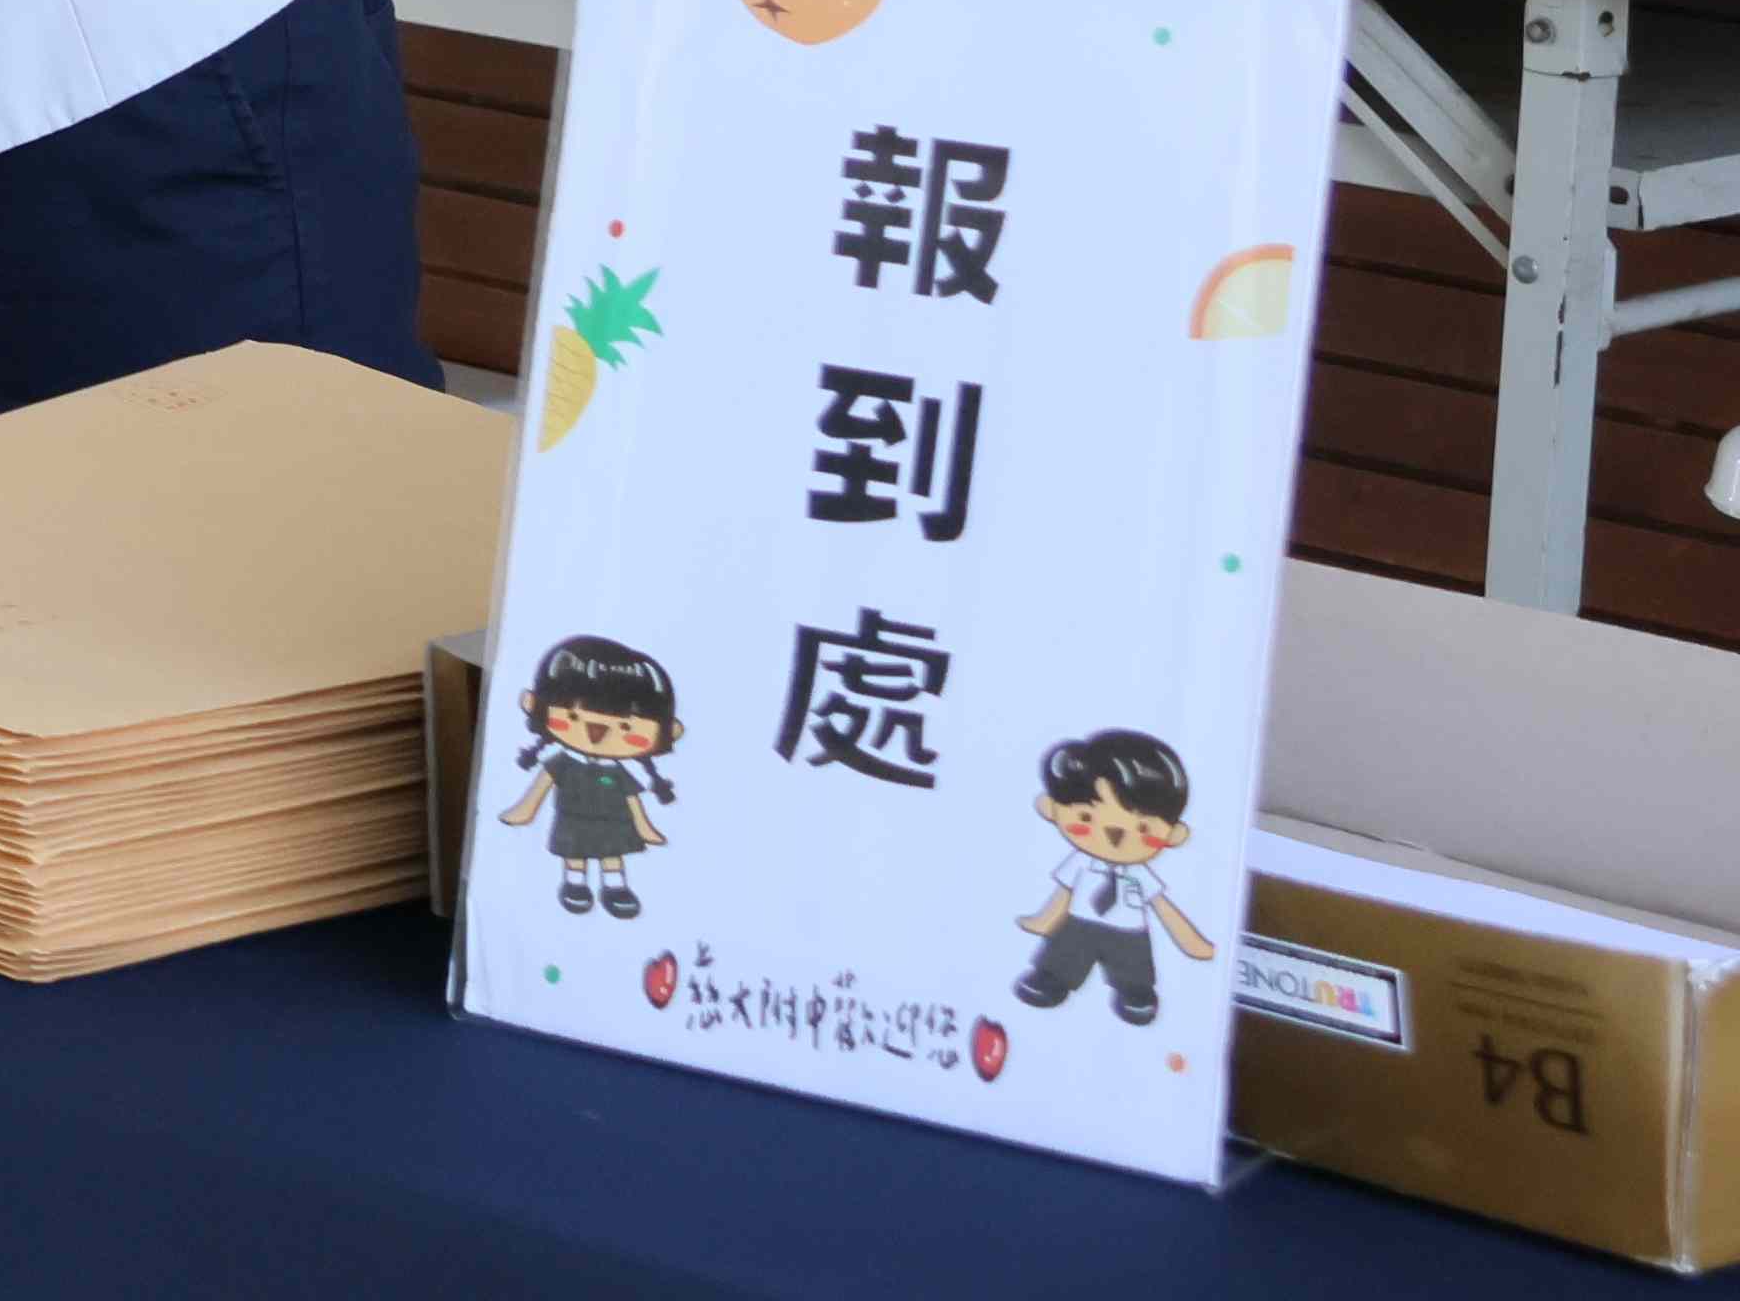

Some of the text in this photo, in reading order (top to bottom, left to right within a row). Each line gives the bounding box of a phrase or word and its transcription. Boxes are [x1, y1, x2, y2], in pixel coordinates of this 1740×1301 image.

[770, 123, 1014, 791] 報到處
[1471, 1032, 1591, 1138] B4
